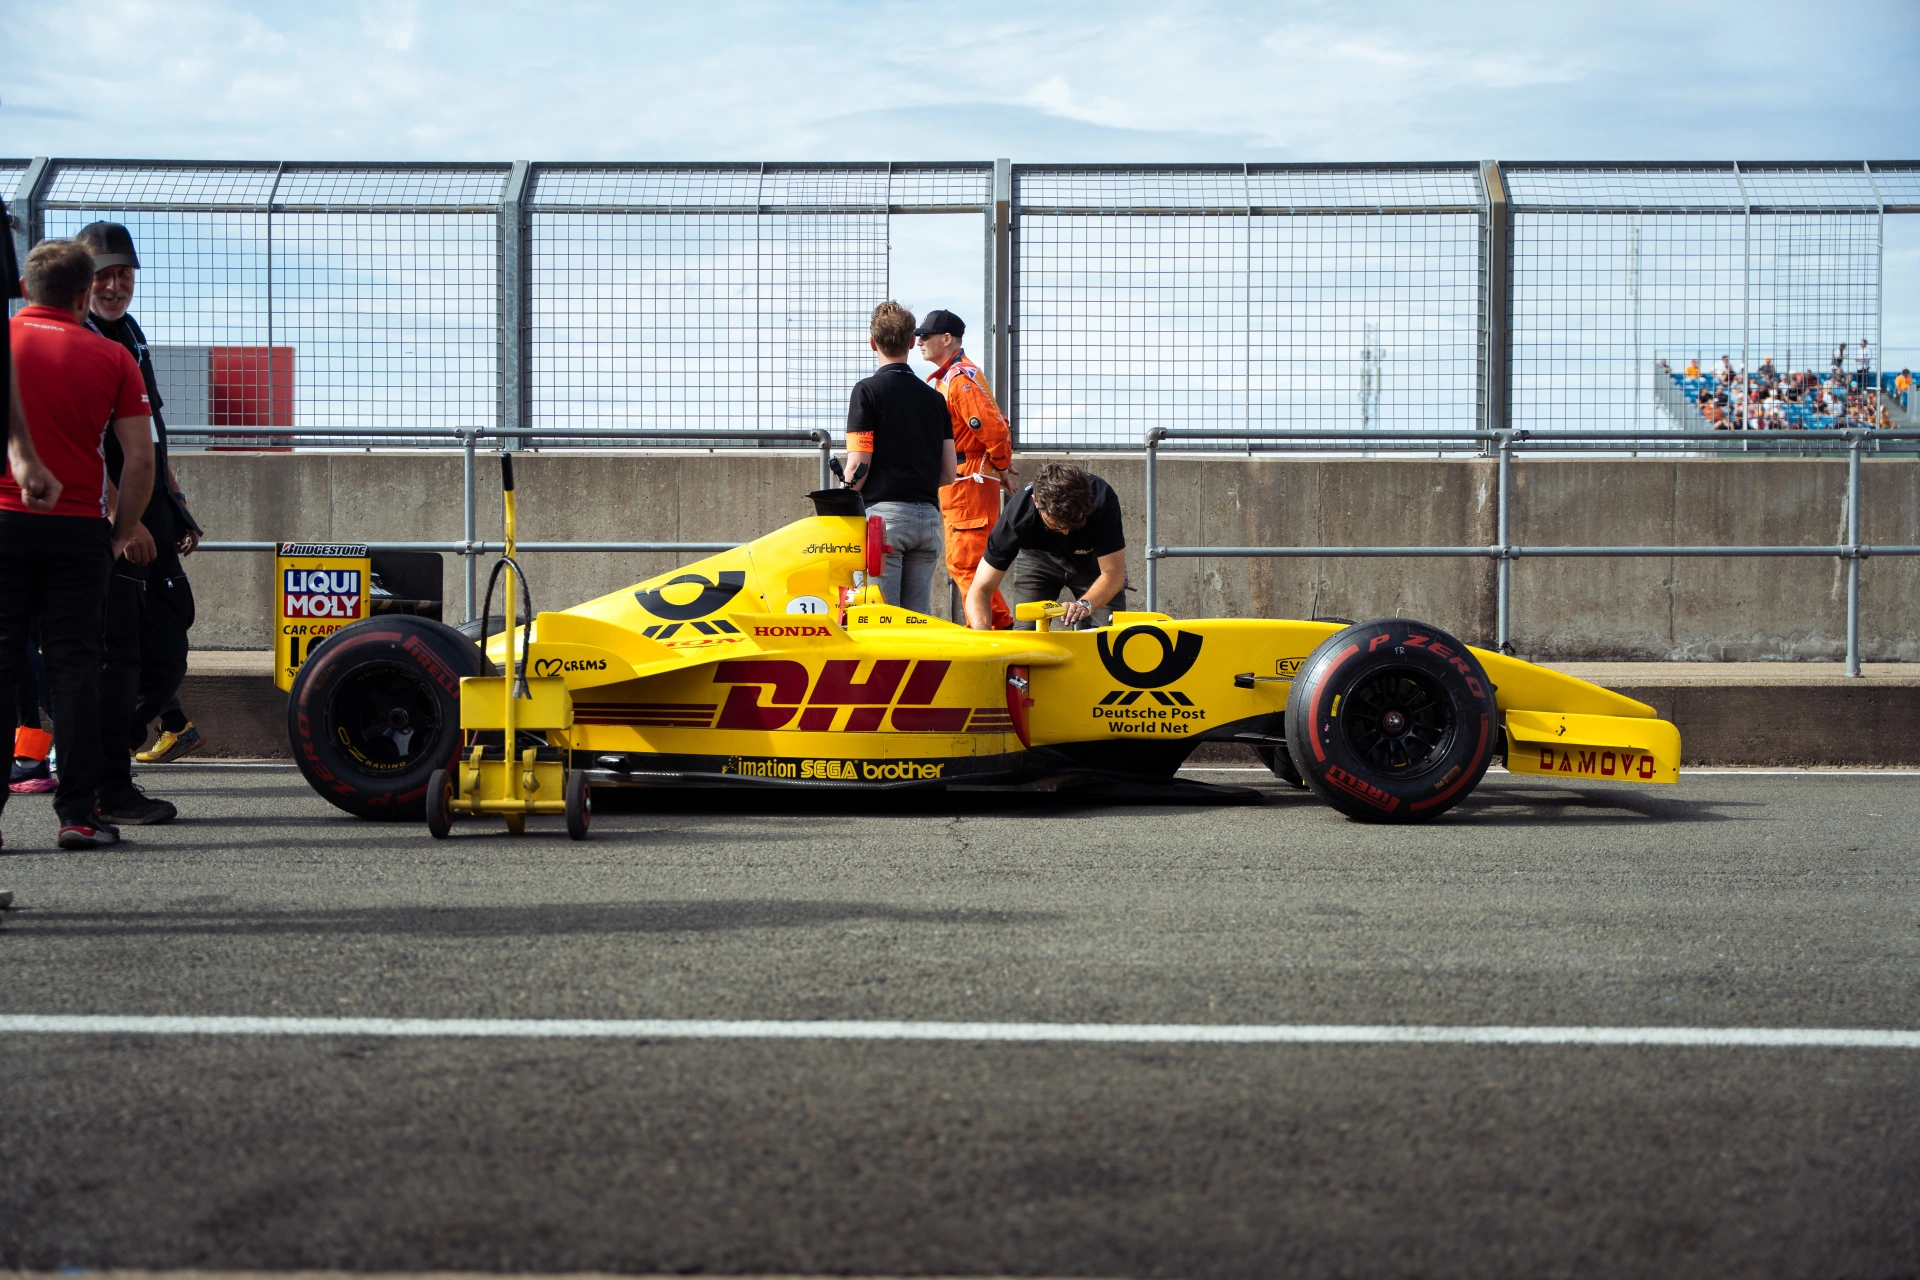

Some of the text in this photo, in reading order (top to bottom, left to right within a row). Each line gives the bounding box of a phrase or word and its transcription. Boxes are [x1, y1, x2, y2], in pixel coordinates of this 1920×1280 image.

[280, 542, 367, 556] BRIDGESTONE
[287, 571, 358, 594] LIQUI
[287, 594, 360, 617] MOLY
[858, 616, 869, 624] BE
[879, 616, 892, 624] ON
[283, 625, 307, 635] CAR
[753, 626, 833, 637] HONDA
[563, 659, 607, 672] CREMS
[1280, 660, 1304, 671] EV
[1368, 634, 1486, 698] P ZERO
[712, 659, 953, 732] DHL
[1092, 707, 1206, 720] Deutsche Post
[1108, 721, 1189, 733] World Net
[297, 712, 358, 796] ZERO
[365, 759, 407, 769] RACING
[738, 757, 797, 778] imation
[862, 761, 945, 780] brother
[1539, 748, 1655, 779] DAMOVO
[1324, 765, 1400, 813] PIRELLI
